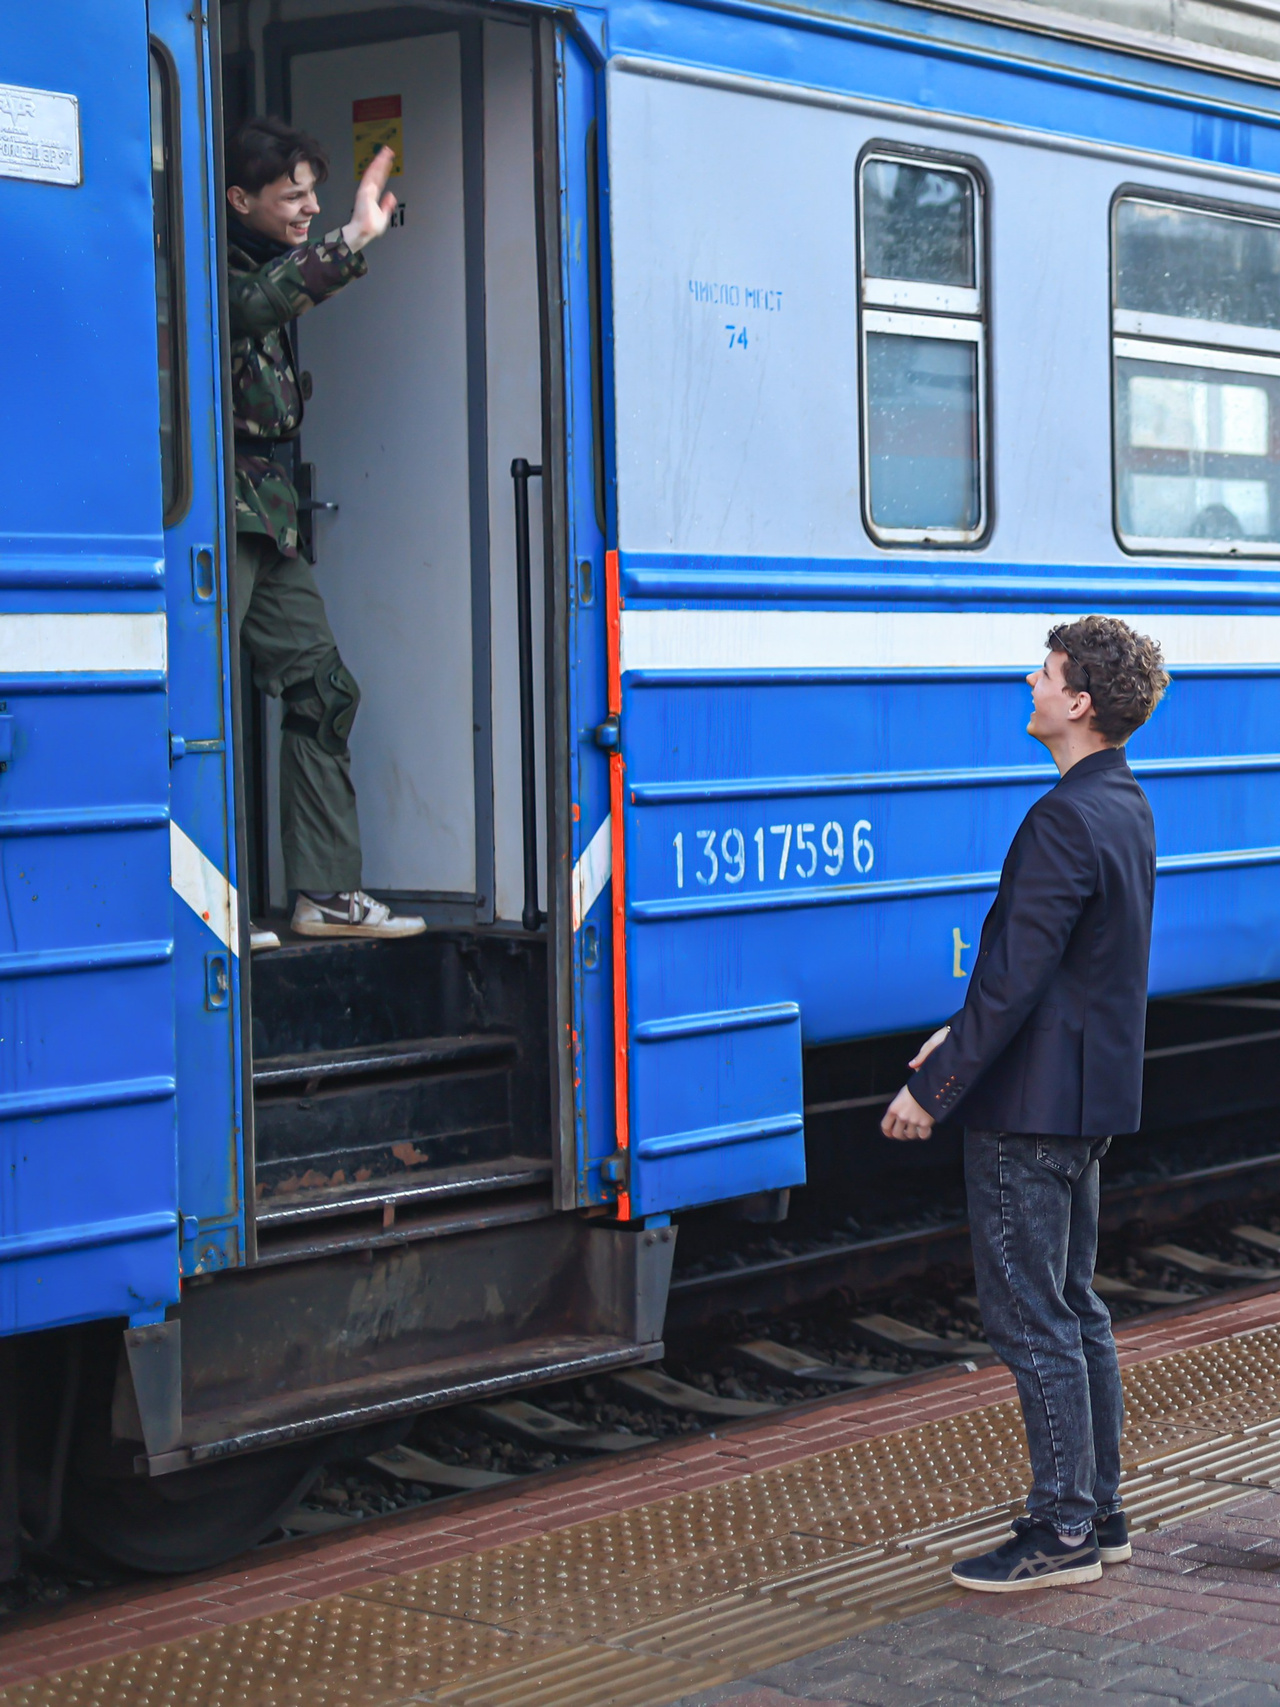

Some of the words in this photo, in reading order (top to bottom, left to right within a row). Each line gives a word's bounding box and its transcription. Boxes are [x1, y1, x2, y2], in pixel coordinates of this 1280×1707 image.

[688, 279, 740, 307] ЧИСЛО
[745, 287, 783, 312] МЕСТ
[725, 325, 748, 350] 74
[674, 819, 875, 889] 13917596
